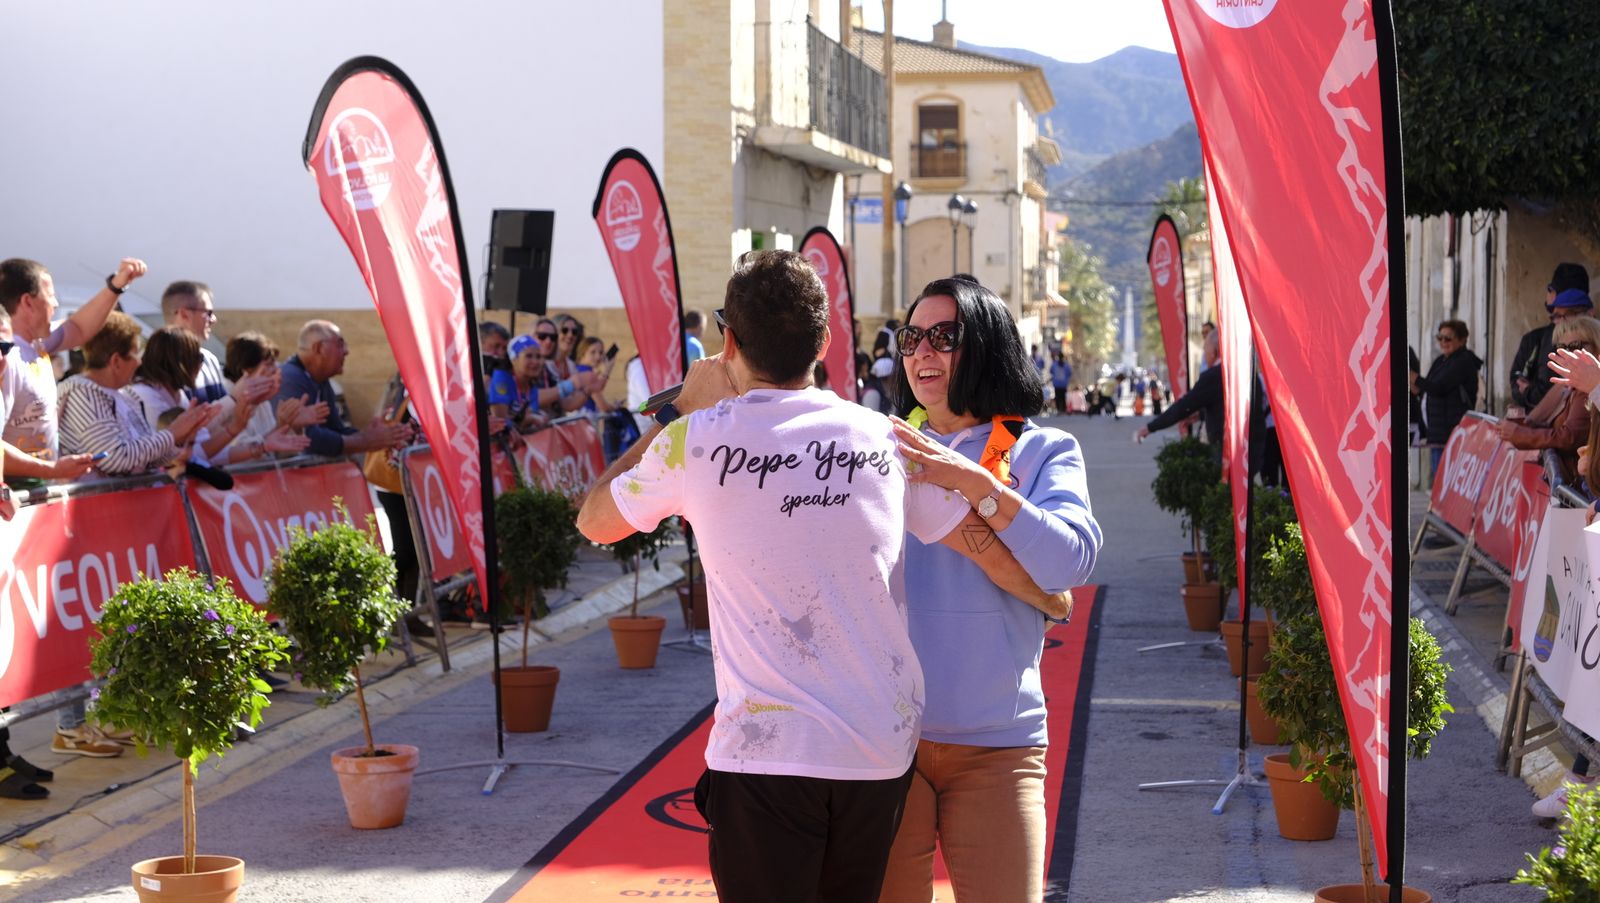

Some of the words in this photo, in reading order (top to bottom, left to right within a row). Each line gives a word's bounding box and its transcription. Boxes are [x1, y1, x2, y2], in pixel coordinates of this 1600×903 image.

[710, 445, 802, 489] Pepe
[806, 440, 892, 483] Yepes
[780, 486, 850, 517] speaker
